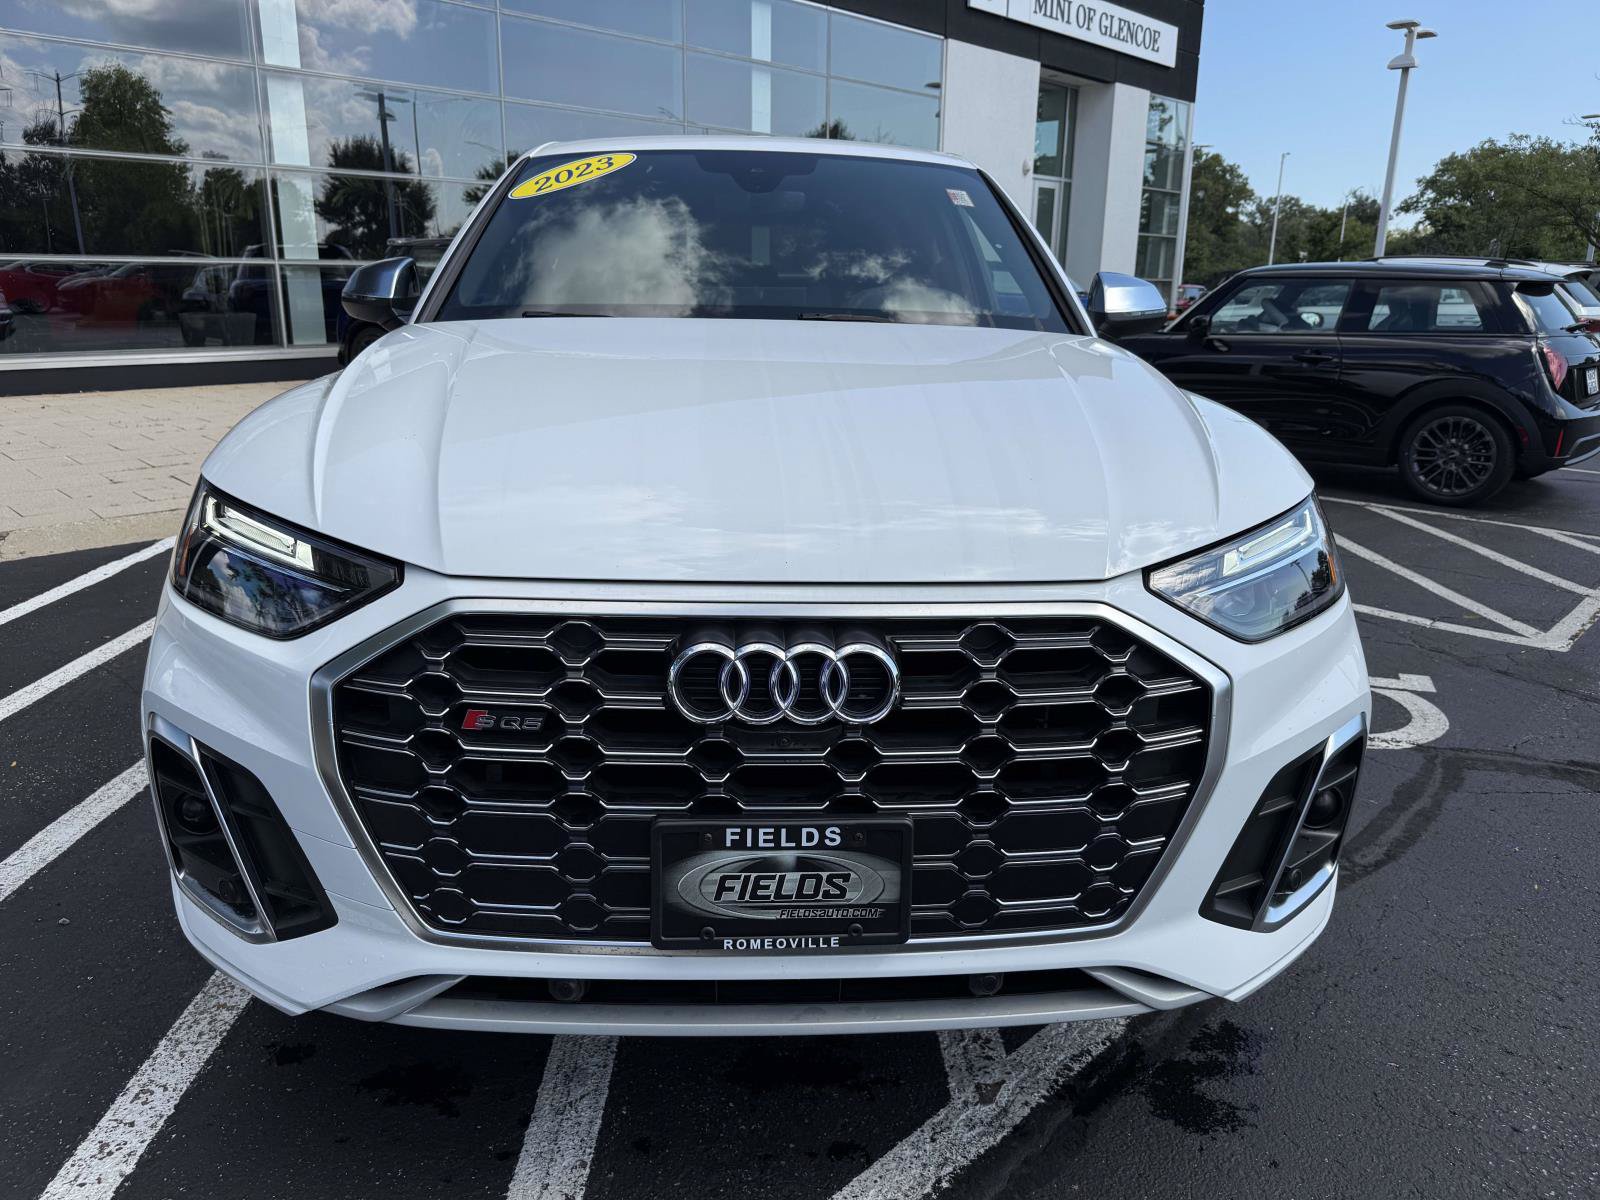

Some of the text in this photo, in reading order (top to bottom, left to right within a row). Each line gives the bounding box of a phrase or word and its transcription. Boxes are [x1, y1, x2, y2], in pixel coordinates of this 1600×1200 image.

[1033, 0, 1161, 53] MINI OF GLENCOE
[534, 156, 614, 193] 2023
[474, 714, 543, 731] SQ5
[725, 826, 842, 848] FIELDS
[713, 872, 852, 903] FIELDS
[723, 936, 840, 950] ROMEOVILLE
